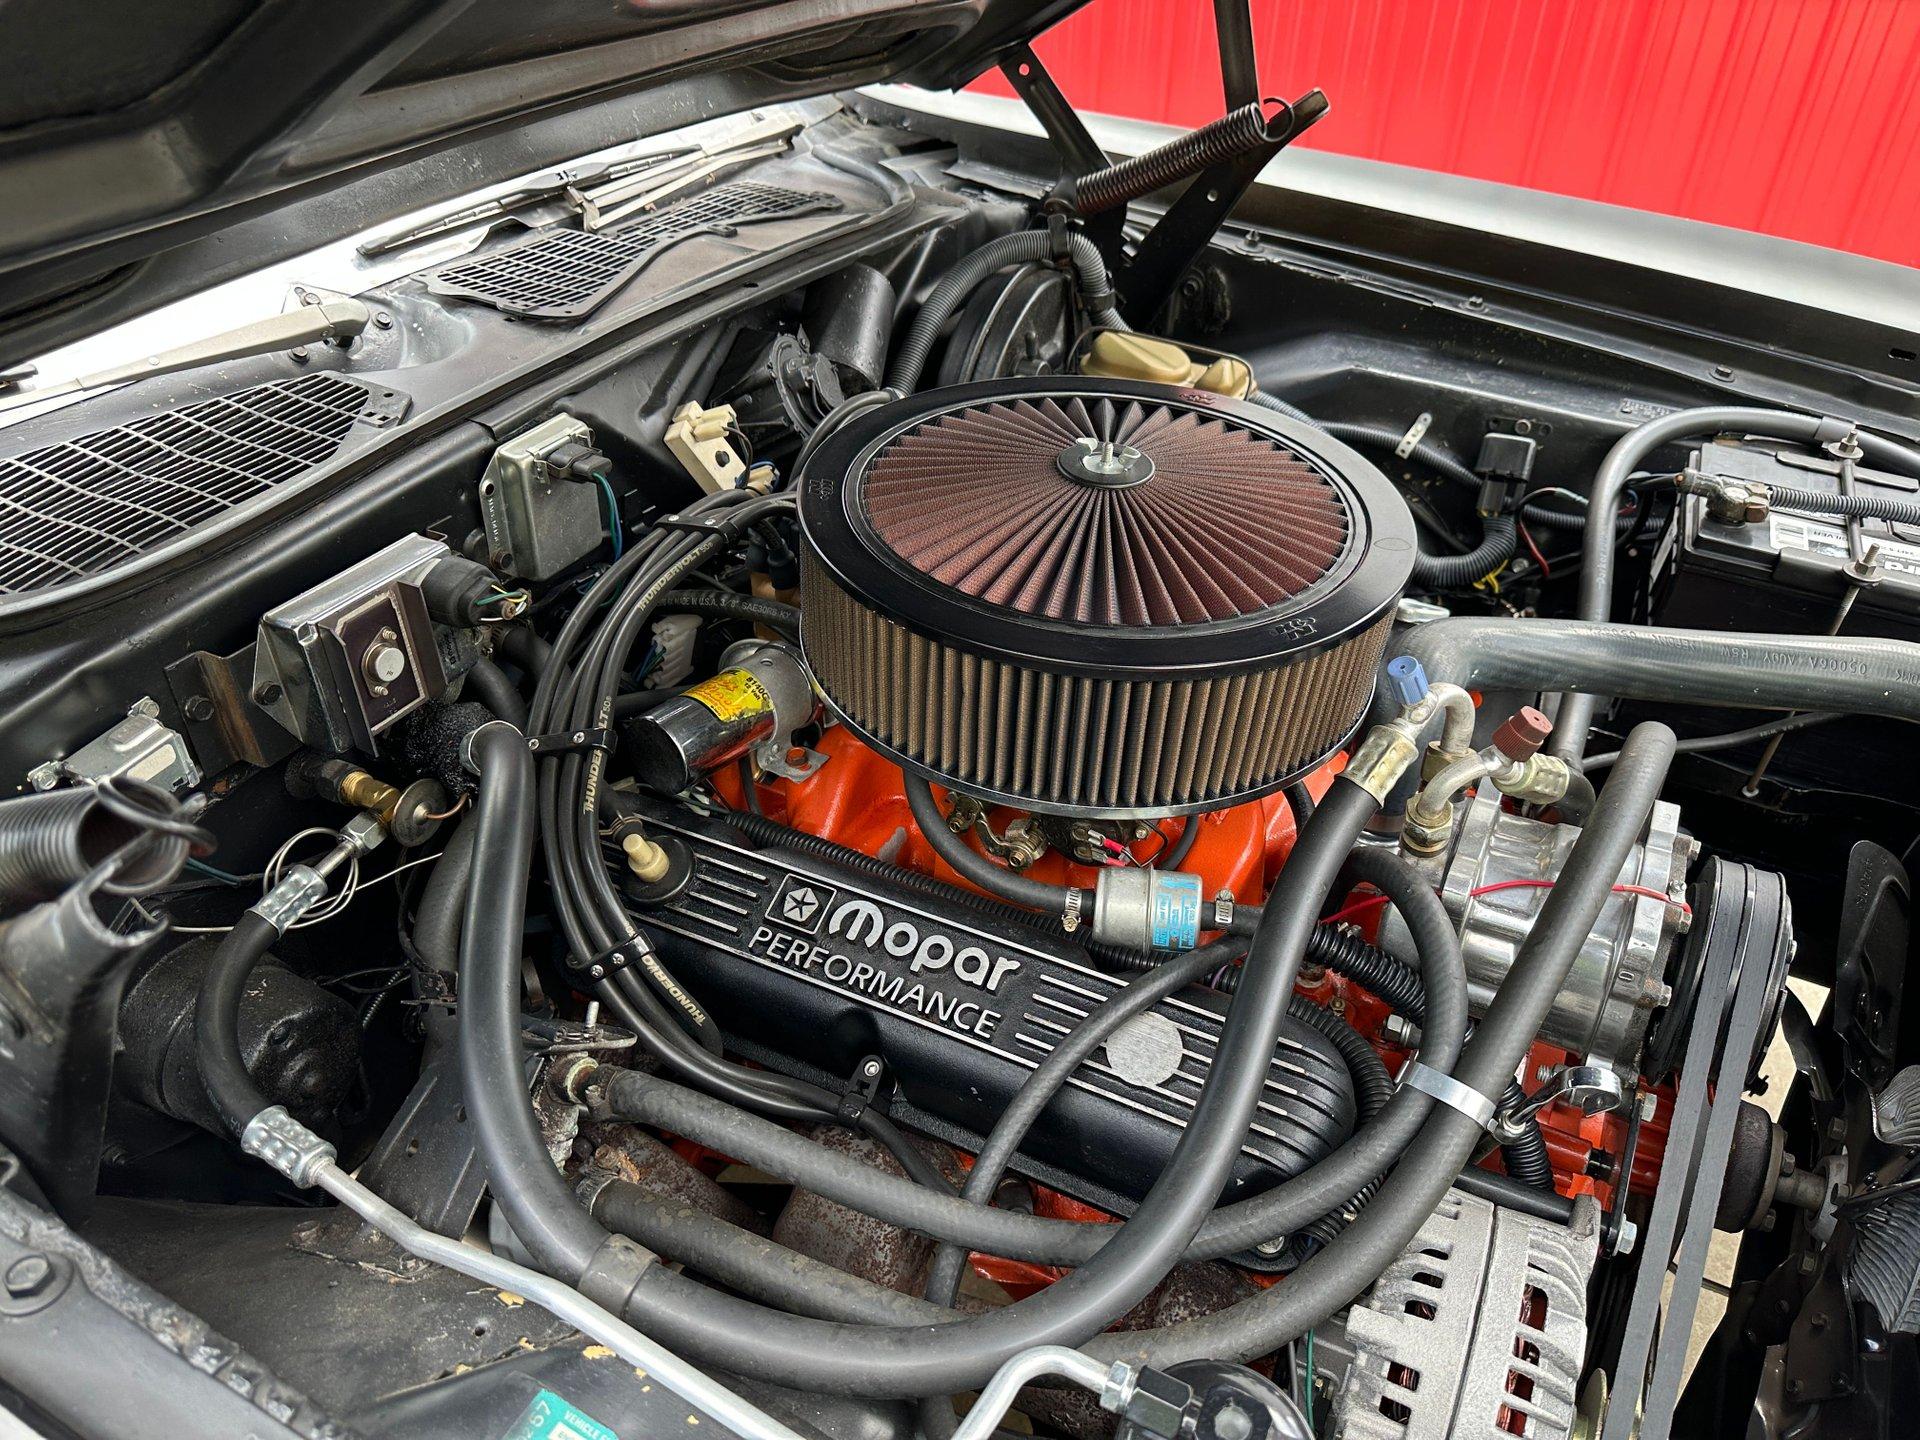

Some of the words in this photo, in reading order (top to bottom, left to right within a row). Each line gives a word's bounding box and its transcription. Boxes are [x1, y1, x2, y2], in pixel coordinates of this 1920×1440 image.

[638, 548, 701, 612] THUNDERVOLT
[583, 708, 610, 815] THUNDELT
[748, 926, 1002, 1039] PERFORMANCE
[828, 900, 1021, 991] Mopar
[564, 1410, 600, 1440] VEHICLE
